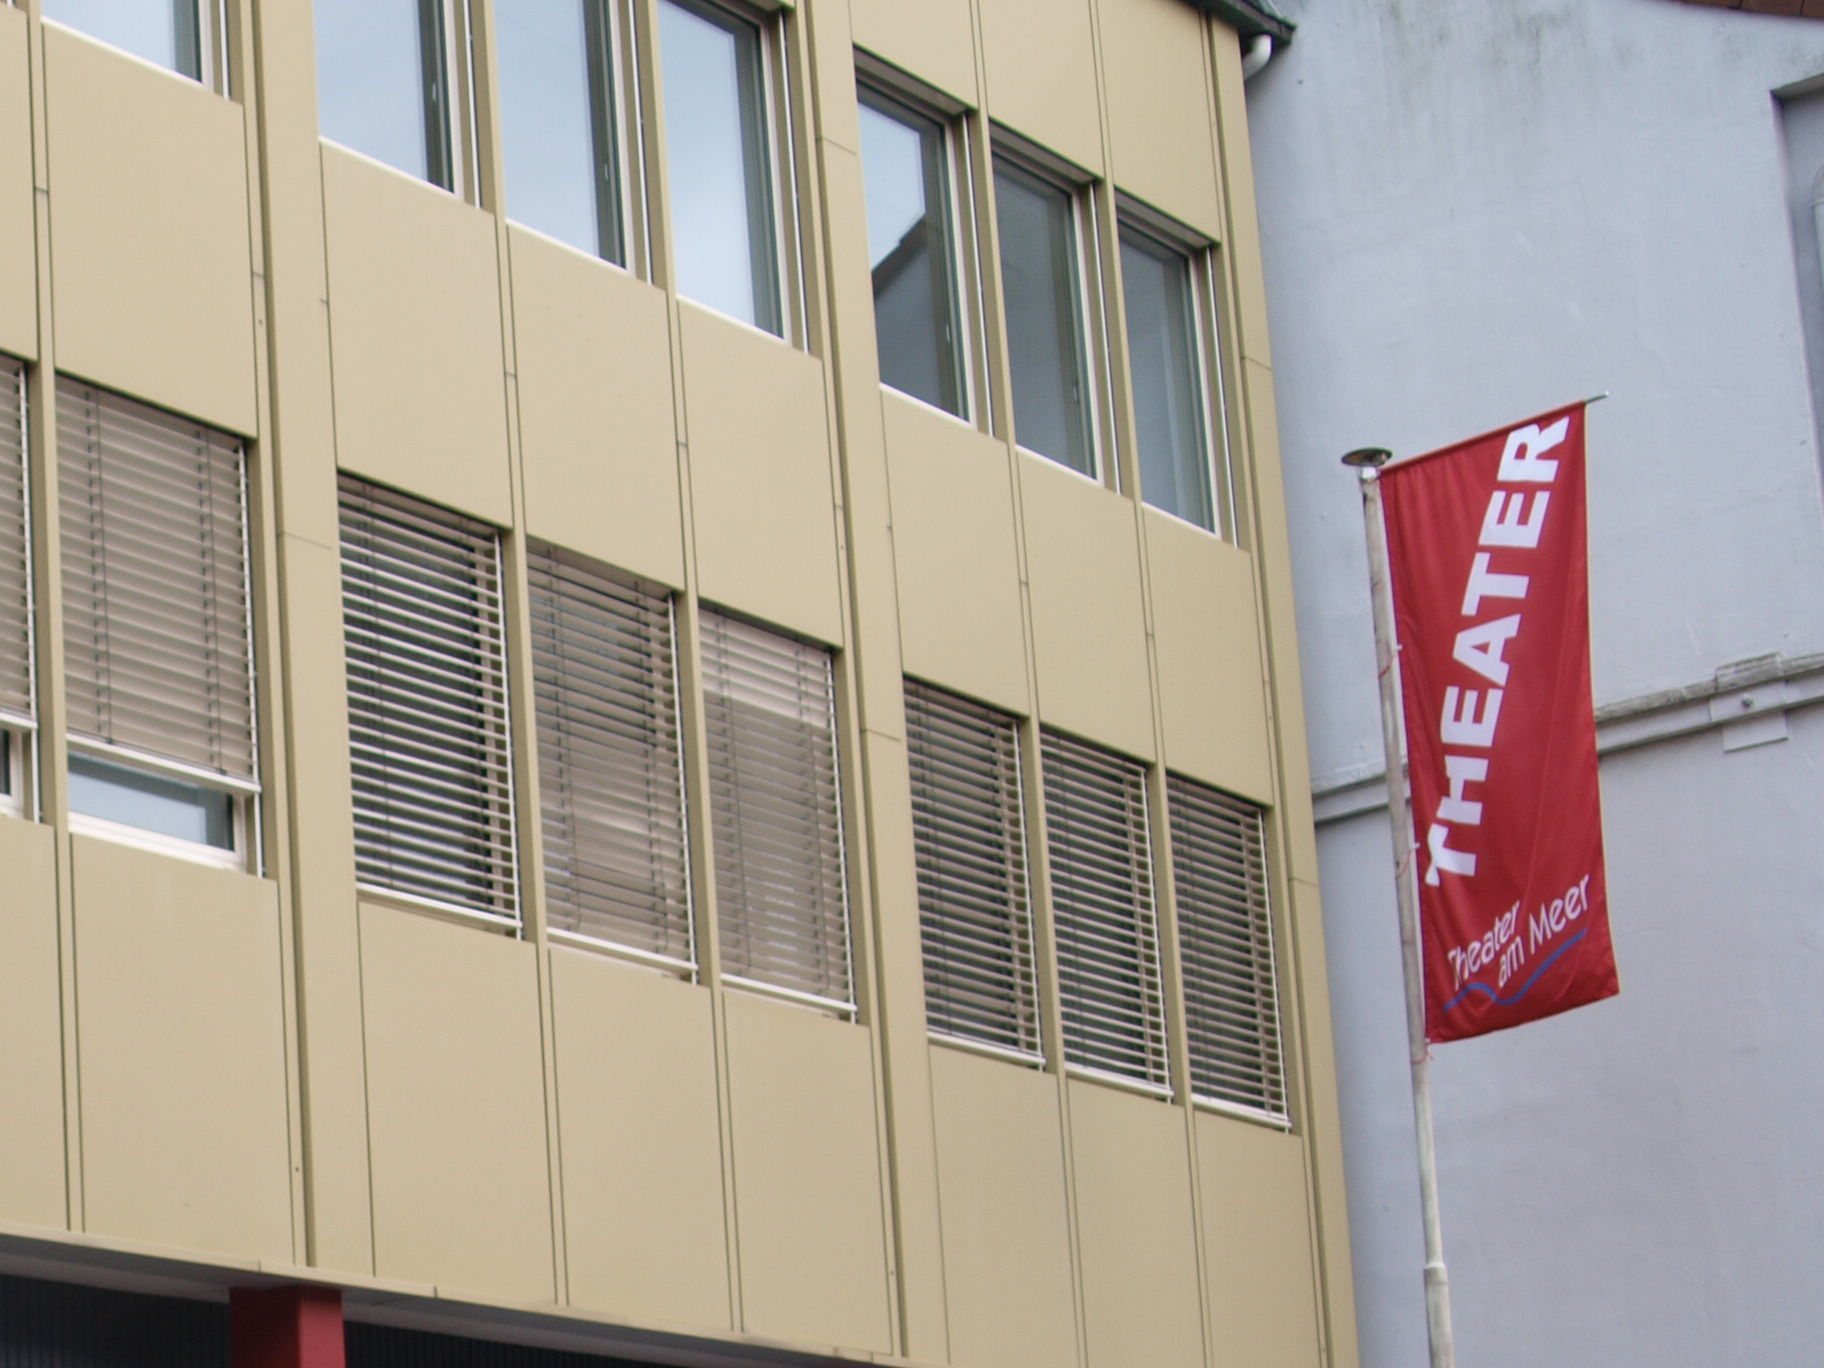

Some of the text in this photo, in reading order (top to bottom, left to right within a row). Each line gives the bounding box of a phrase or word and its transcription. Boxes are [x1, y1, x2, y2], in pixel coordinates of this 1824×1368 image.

[1425, 415, 1569, 887] THEATER
[1447, 900, 1521, 991] Theater
[1498, 873, 1590, 989] am Meer
